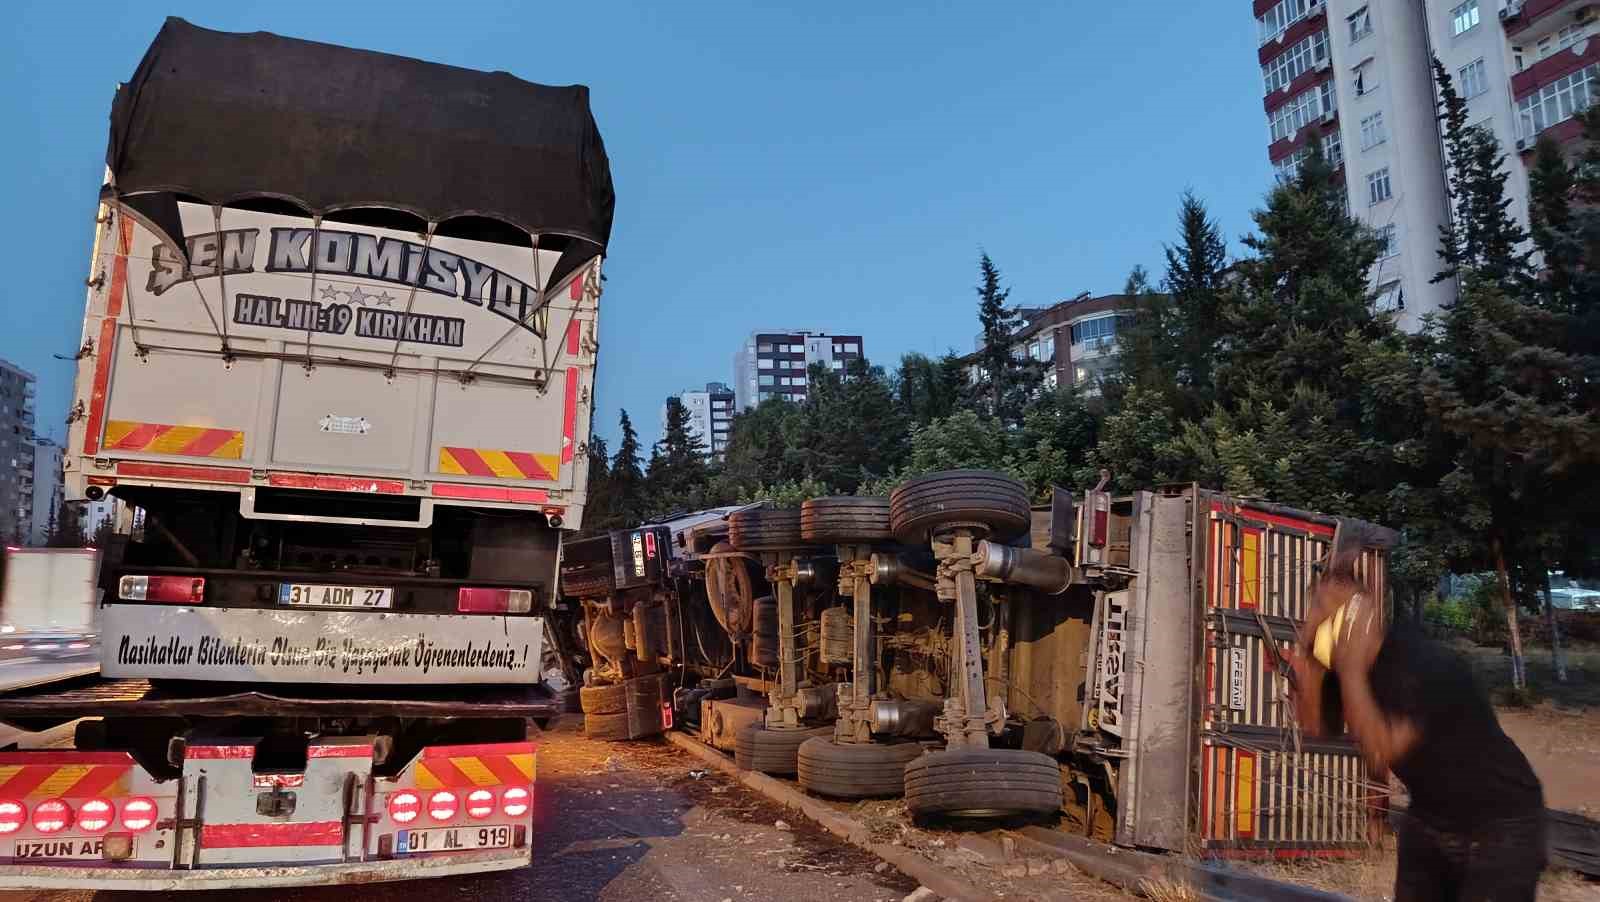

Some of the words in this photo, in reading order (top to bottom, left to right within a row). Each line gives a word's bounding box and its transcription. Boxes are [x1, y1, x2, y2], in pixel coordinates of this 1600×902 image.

[234, 294, 283, 328] HAL
[356, 308, 465, 346] KIRIKHAN
[291, 586, 312, 603] 31
[321, 588, 353, 605] ADM
[363, 590, 385, 606] 27
[118, 635, 193, 665] Nasihatlar
[197, 635, 266, 666] Bilenlerin
[16, 842, 73, 857] UZUN
[409, 831, 428, 850] 01
[444, 829, 463, 849] AL
[478, 827, 508, 846] 919
